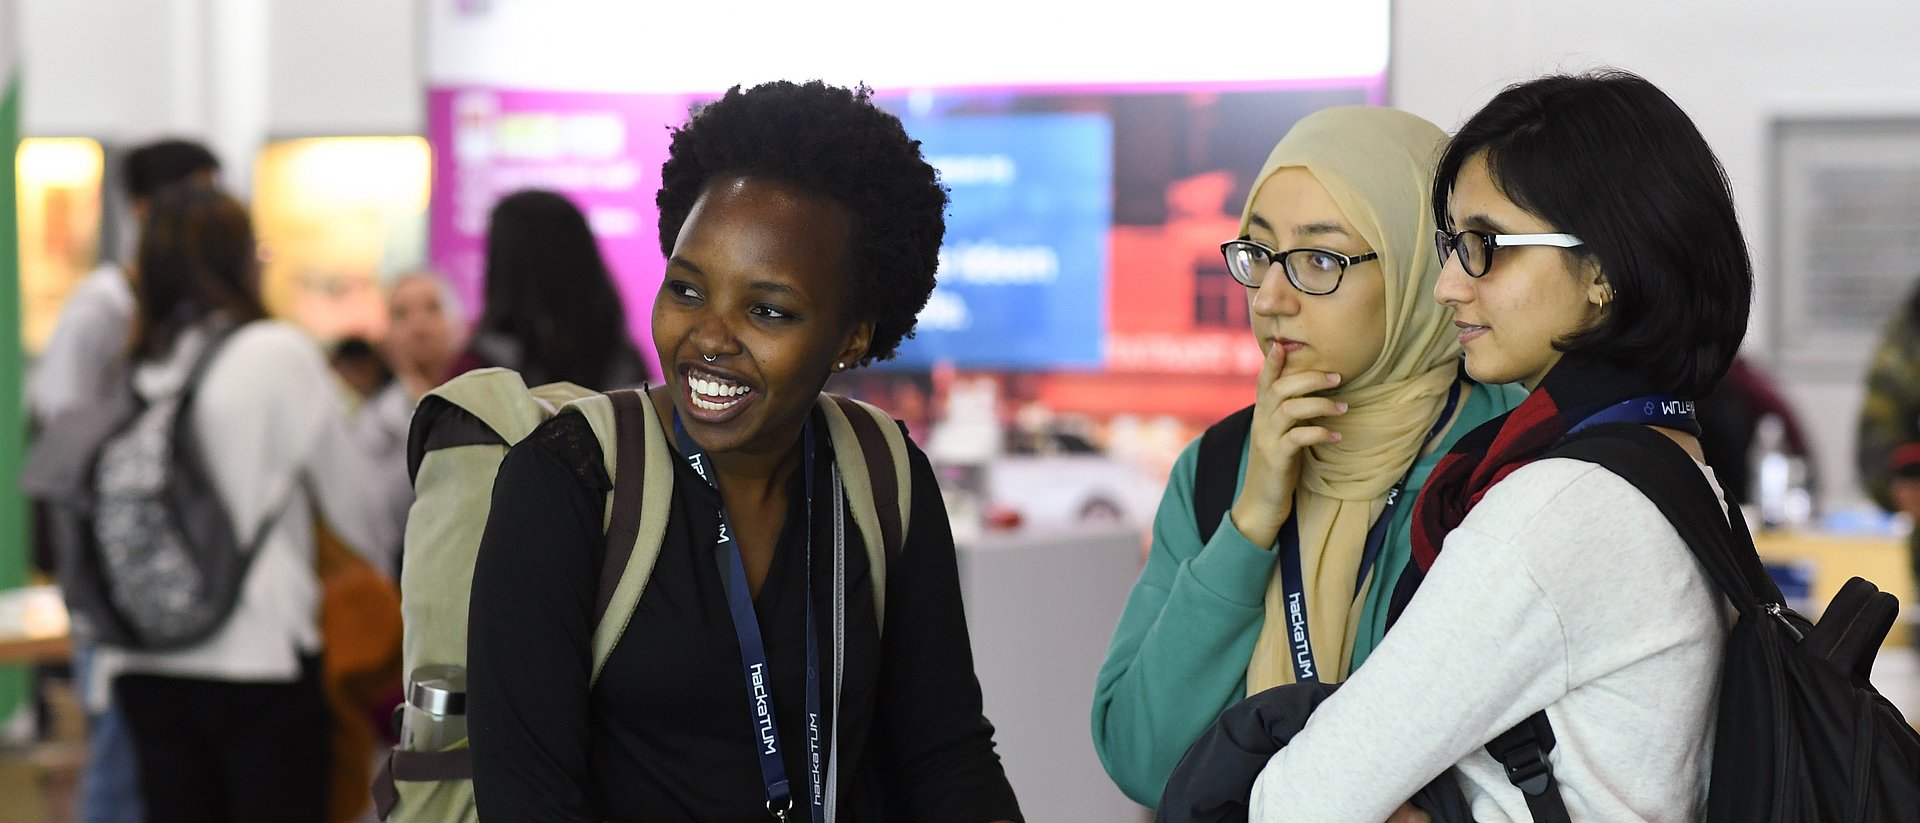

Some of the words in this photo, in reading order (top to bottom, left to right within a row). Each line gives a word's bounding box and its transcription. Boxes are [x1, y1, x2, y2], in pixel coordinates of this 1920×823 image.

[1288, 592, 1314, 679] hackaTUM
[751, 663, 777, 755] hackaTUM
[810, 712, 822, 806] hackaTUM
